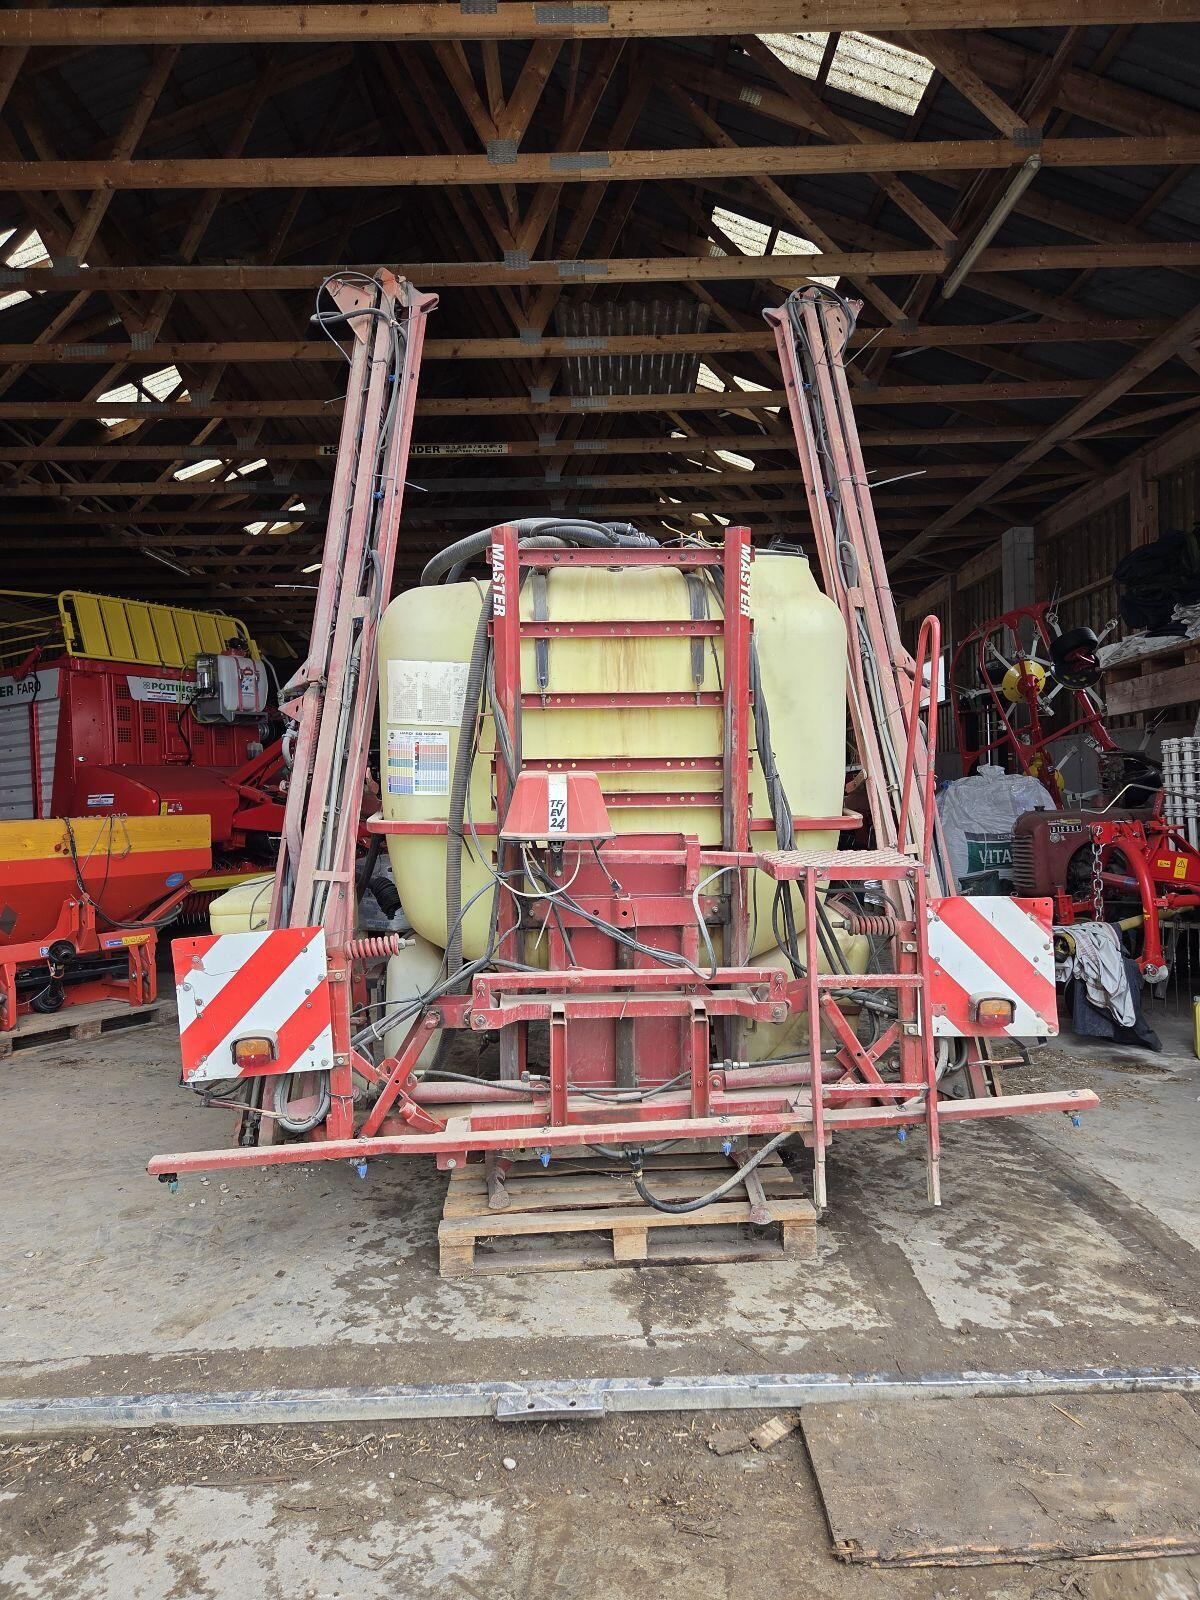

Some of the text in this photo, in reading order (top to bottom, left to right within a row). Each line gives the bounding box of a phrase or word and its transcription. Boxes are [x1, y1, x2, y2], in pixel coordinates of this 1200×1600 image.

[409, 446, 440, 454] NDER
[492, 543, 506, 617] MASTER
[740, 543, 751, 617] MASTER
[0, 680, 41, 697] ER FARO
[550, 817, 566, 830] 24
[978, 848, 1013, 864] VITA
